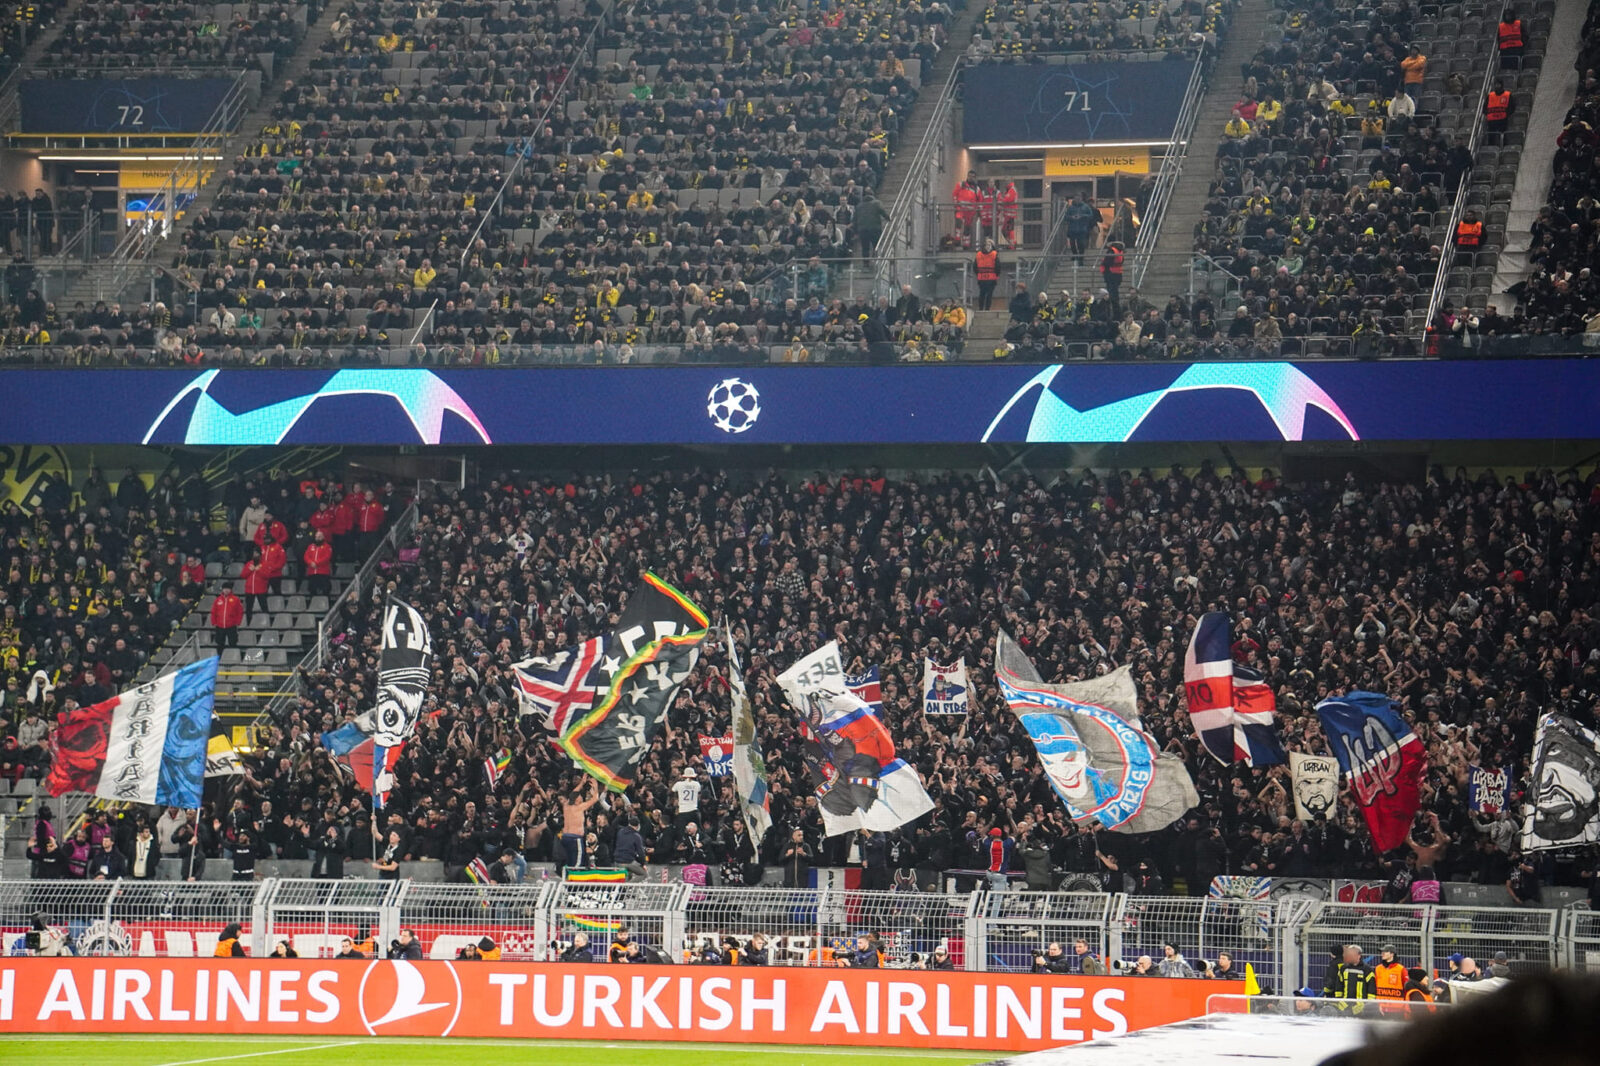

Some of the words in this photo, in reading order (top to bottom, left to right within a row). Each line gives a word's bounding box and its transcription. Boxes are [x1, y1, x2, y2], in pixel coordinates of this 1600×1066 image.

[1064, 91, 1092, 111] 71
[117, 105, 144, 126] 72
[1060, 157, 1099, 167] WEISSE
[1102, 156, 1135, 166] WIESE
[926, 702, 940, 713] ON
[943, 701, 968, 713] FIRE
[1303, 762, 1331, 774] URBAN
[1472, 770, 1509, 790] URBAN
[682, 789, 695, 801] 21
[1106, 770, 1149, 822] PARIS
[36, 968, 341, 1024] AIRLINES
[488, 973, 786, 1032] TURKISH
[810, 980, 1128, 1041] AIRLINES
